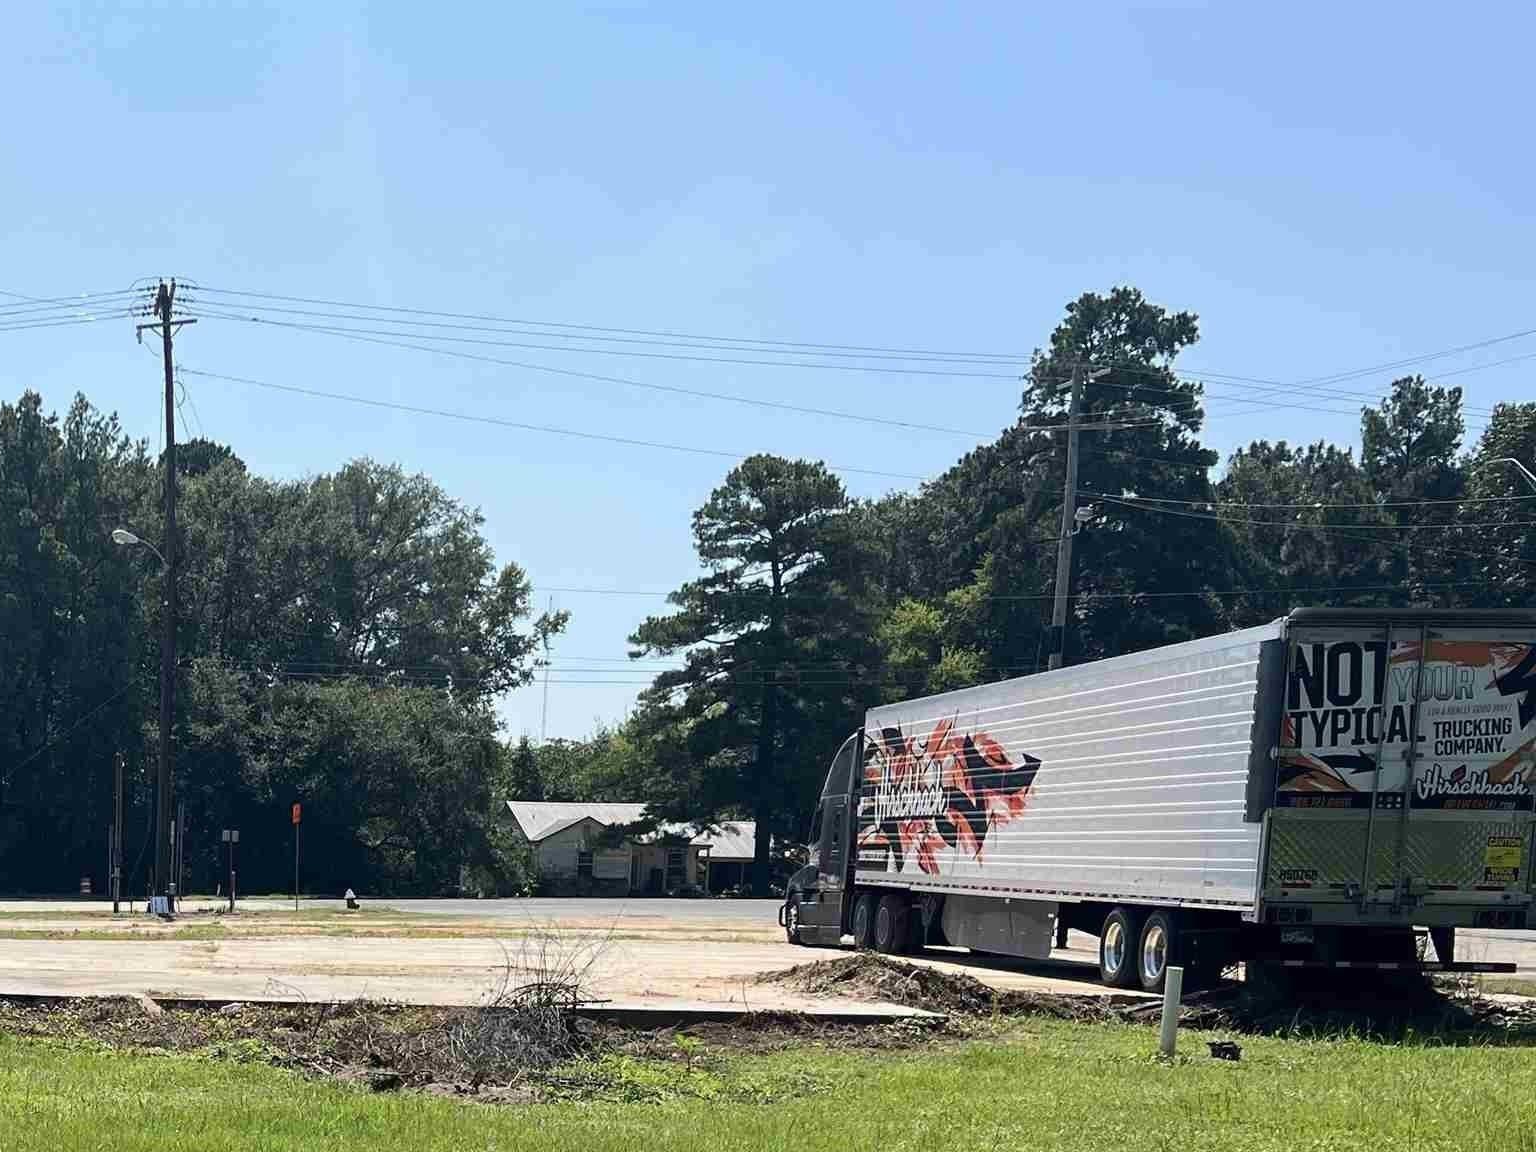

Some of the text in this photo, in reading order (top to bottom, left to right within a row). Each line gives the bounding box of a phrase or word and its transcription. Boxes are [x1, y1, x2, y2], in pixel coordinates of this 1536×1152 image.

[1287, 640, 1475, 709] NOT YOUR
[1289, 703, 1426, 748] TYPICAL
[1433, 716, 1513, 739] TRUCKING
[1434, 736, 1507, 756] COMPANY.
